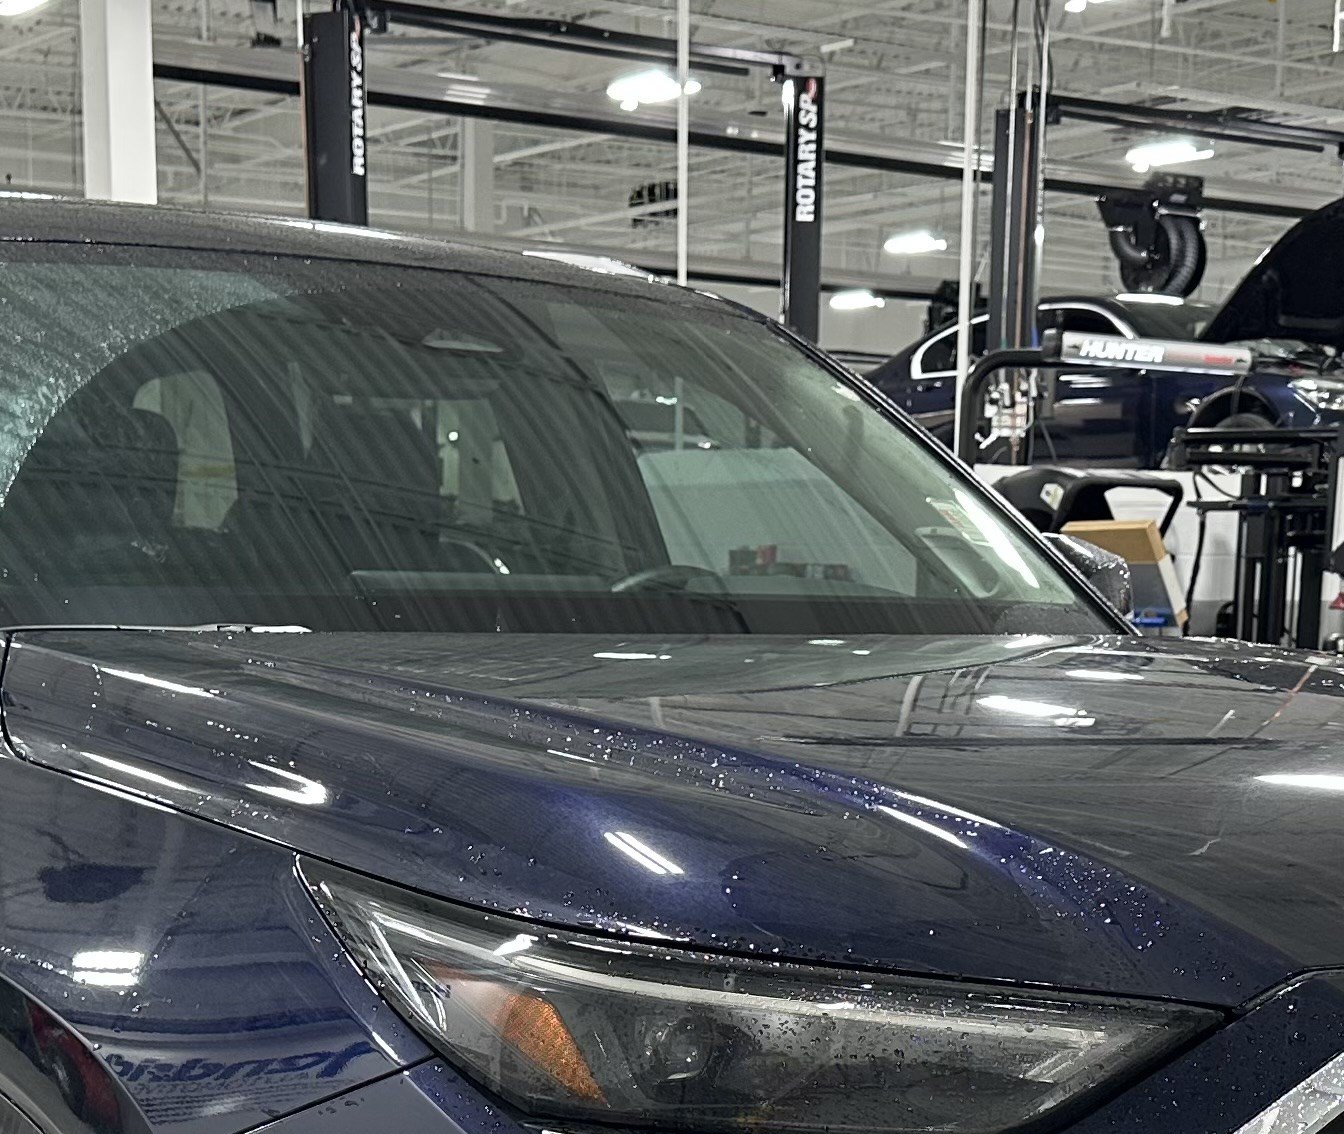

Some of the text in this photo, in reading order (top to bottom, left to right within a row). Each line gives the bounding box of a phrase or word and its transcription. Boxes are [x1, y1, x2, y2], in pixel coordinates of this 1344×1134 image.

[350, 70, 365, 176] ROTARY
[796, 92, 818, 222] ROTARY SP
[1079, 339, 1165, 363] HUNTER
